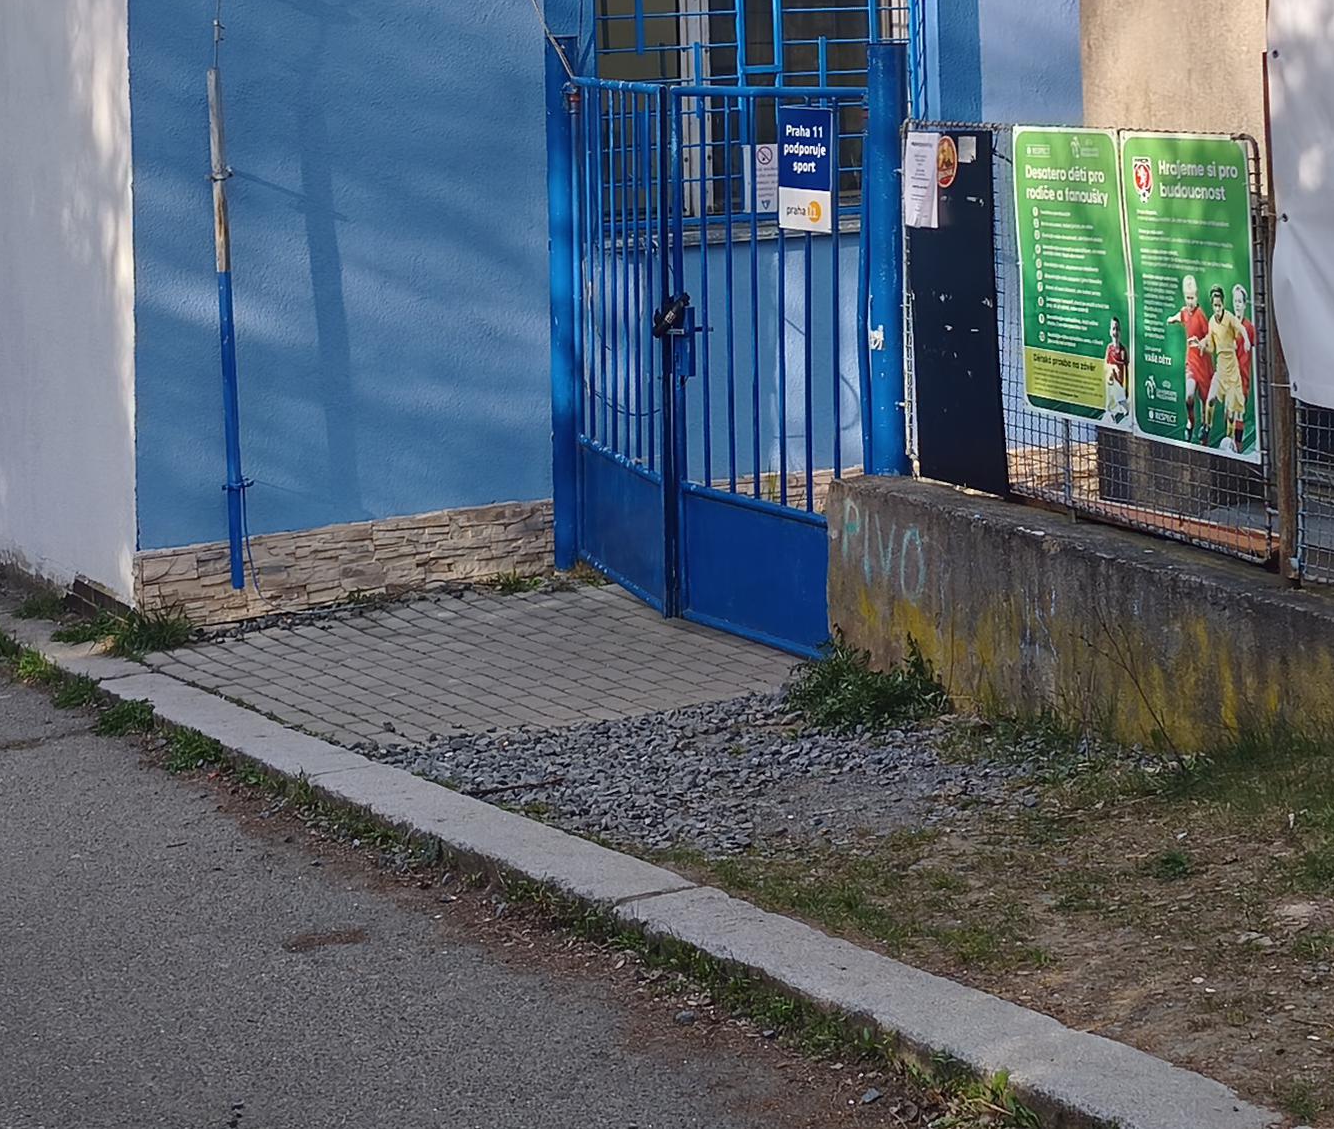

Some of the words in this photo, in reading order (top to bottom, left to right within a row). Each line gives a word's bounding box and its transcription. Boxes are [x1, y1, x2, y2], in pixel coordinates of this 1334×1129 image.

[785, 124, 812, 138] Praha
[812, 125, 824, 138] 11
[783, 141, 827, 159] podporuje
[792, 160, 817, 174] sport
[1025, 164, 1067, 182] Desatero
[1088, 171, 1105, 186] pro
[1158, 159, 1205, 179] Hrajeme
[1207, 160, 1217, 177] si
[1218, 165, 1239, 181] pro
[1026, 184, 1055, 201] rodiče
[1056, 189, 1064, 201] a
[1065, 187, 1109, 208] fanoušky
[1159, 182, 1227, 201] budoucnost
[786, 204, 806, 216] praha
[841, 496, 928, 601] PIVO
